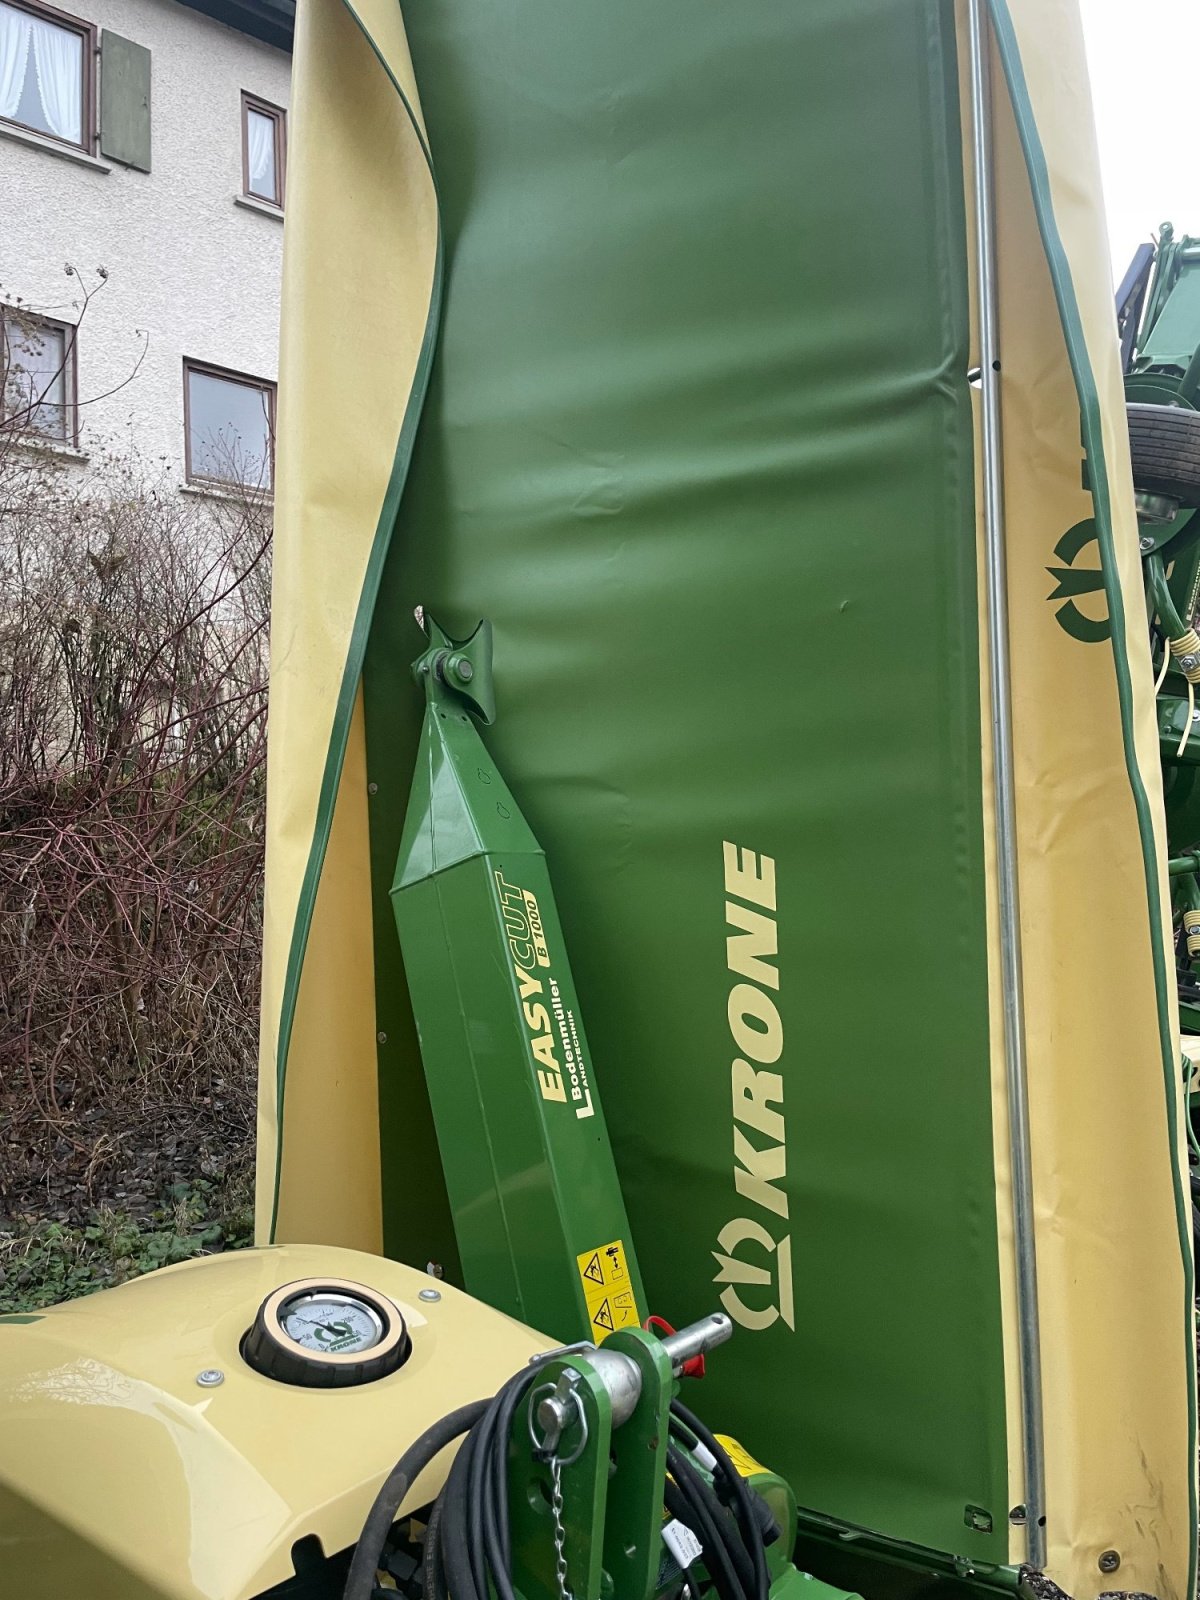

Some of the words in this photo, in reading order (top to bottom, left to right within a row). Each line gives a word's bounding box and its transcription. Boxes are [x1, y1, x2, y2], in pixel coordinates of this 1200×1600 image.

[525, 899, 544, 942] 1000
[535, 946, 548, 959] B
[548, 977, 583, 1101] Bodenmüller
[722, 840, 789, 1220] KRONE
[330, 1336, 363, 1352] KRONE
